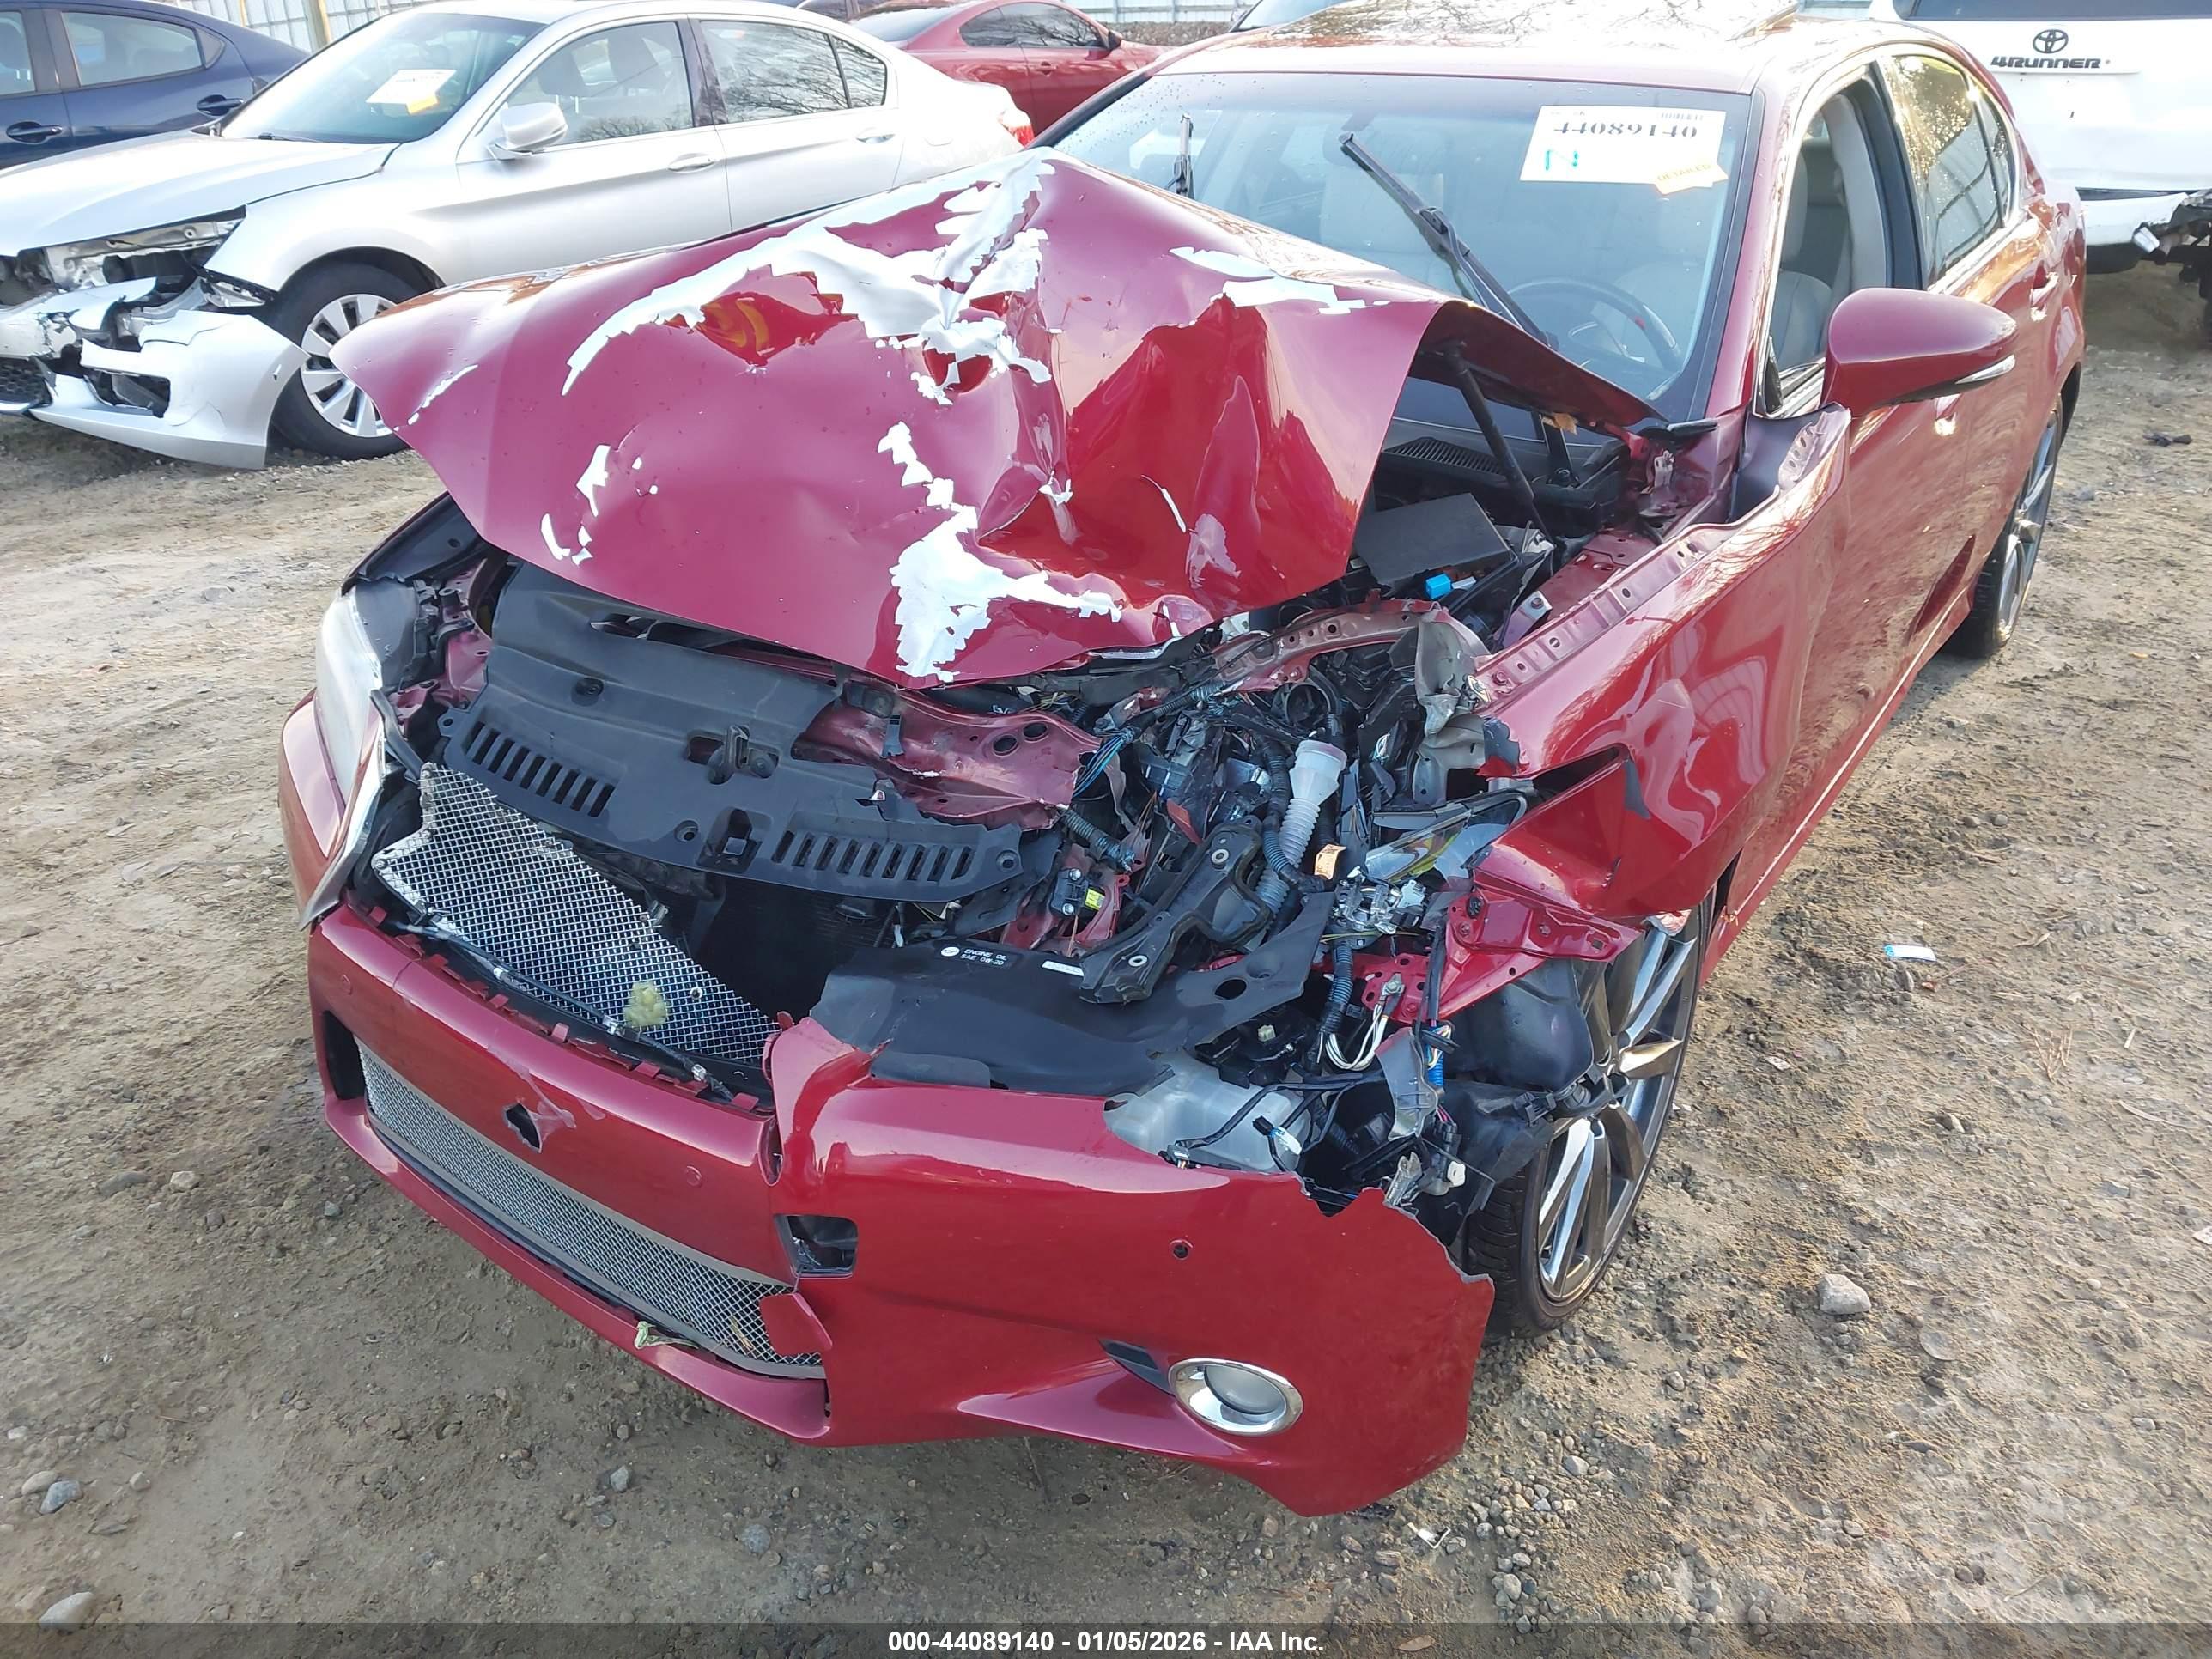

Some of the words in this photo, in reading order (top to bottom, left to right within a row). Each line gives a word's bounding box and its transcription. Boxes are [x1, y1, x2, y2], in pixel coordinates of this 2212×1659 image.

[1990, 56, 2101, 69] 4RUNNER
[1554, 123, 1698, 137] 44089140
[963, 949, 991, 957] ENGINE
